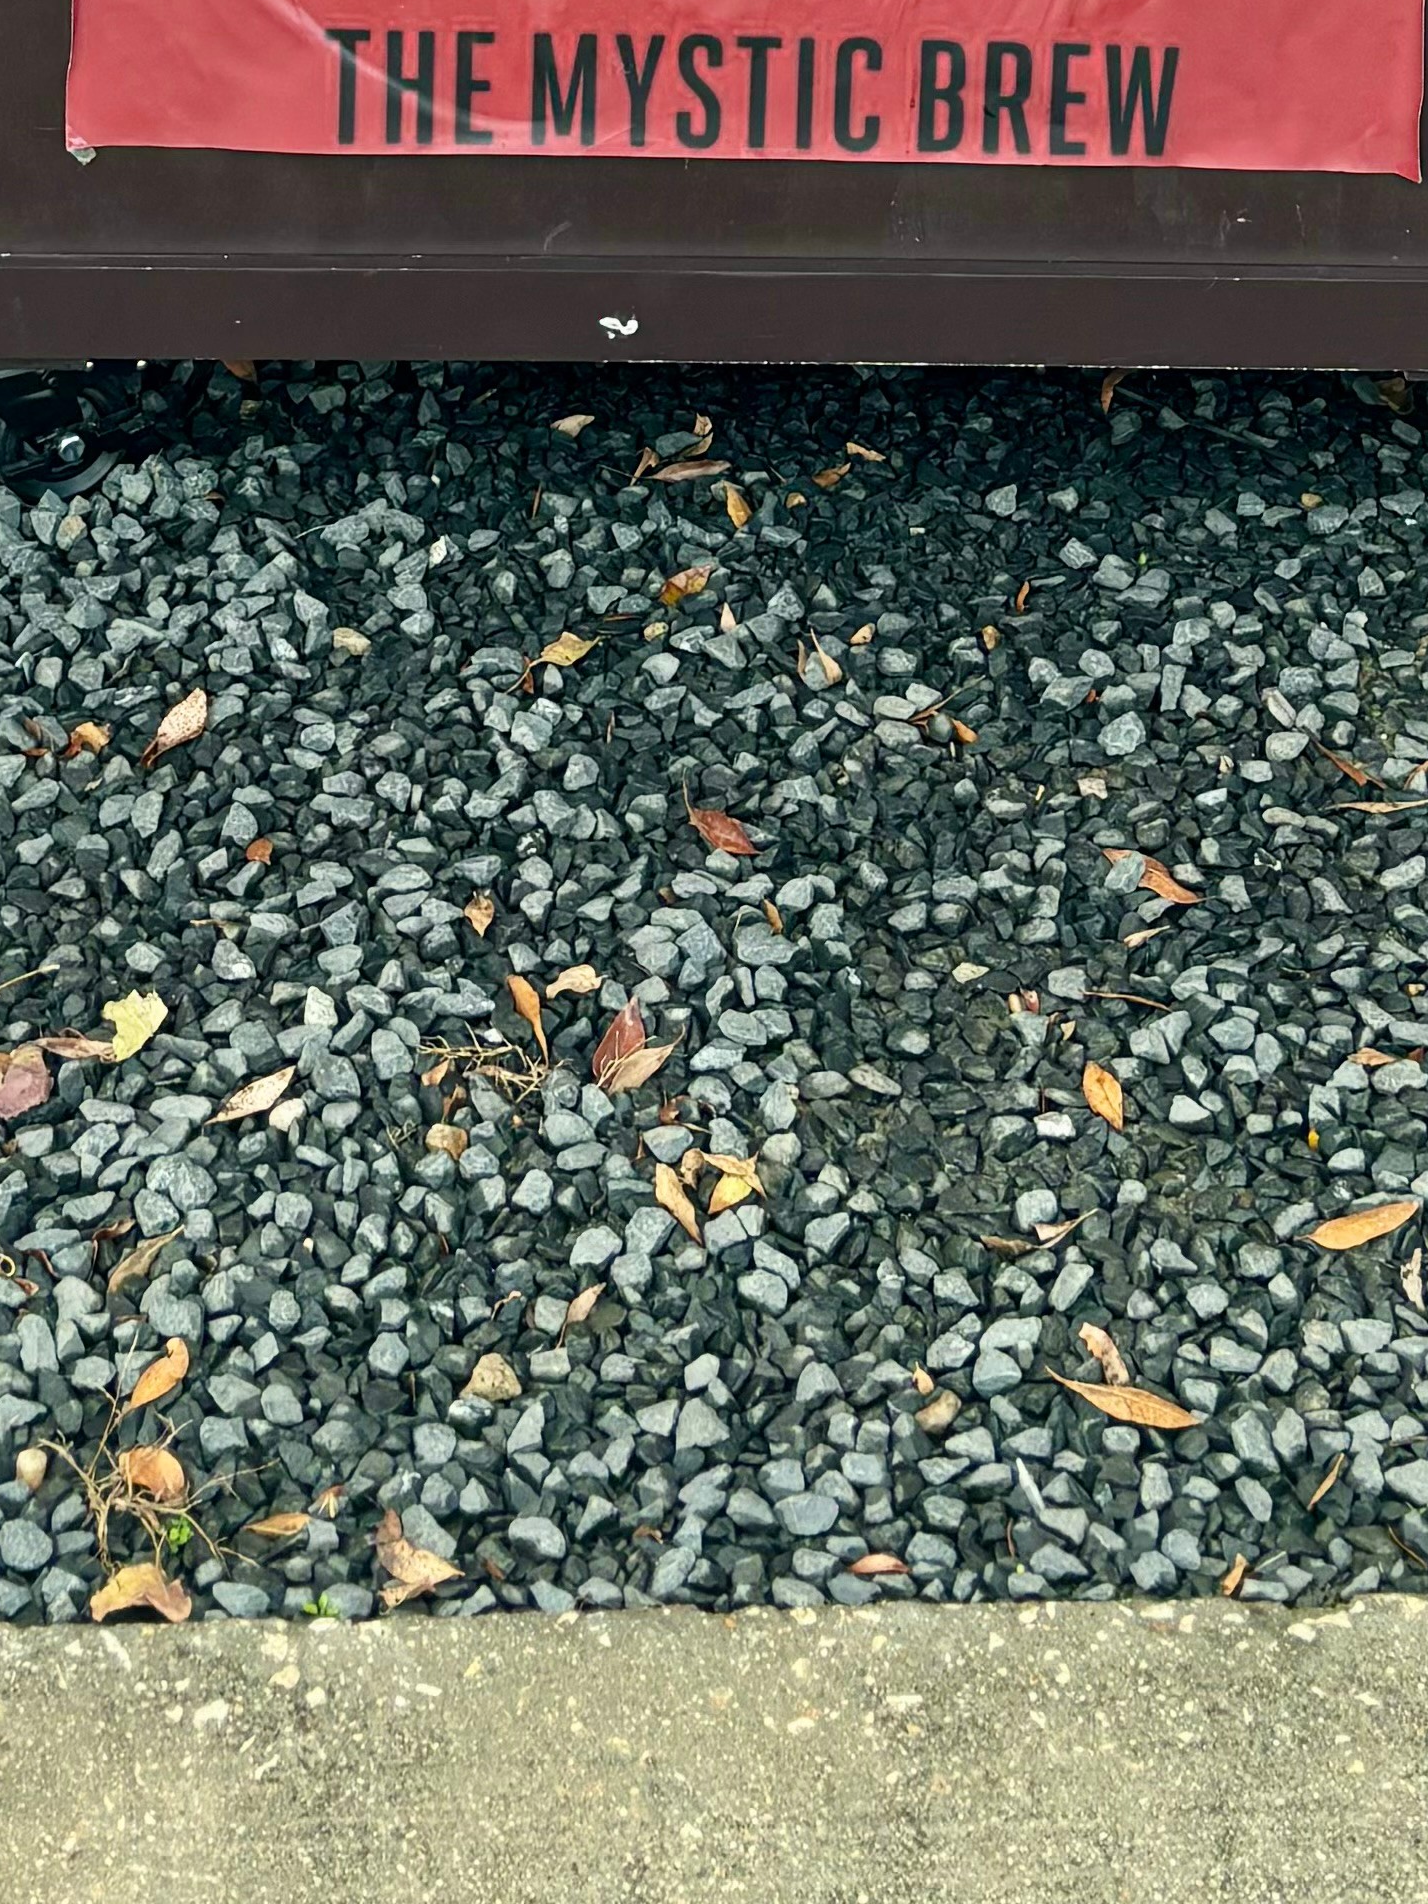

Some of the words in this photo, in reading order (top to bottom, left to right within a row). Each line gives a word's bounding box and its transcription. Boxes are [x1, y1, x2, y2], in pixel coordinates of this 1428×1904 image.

[324, 28, 495, 145] THE
[531, 31, 883, 152] MYSTIC
[916, 38, 1181, 157] BREW
